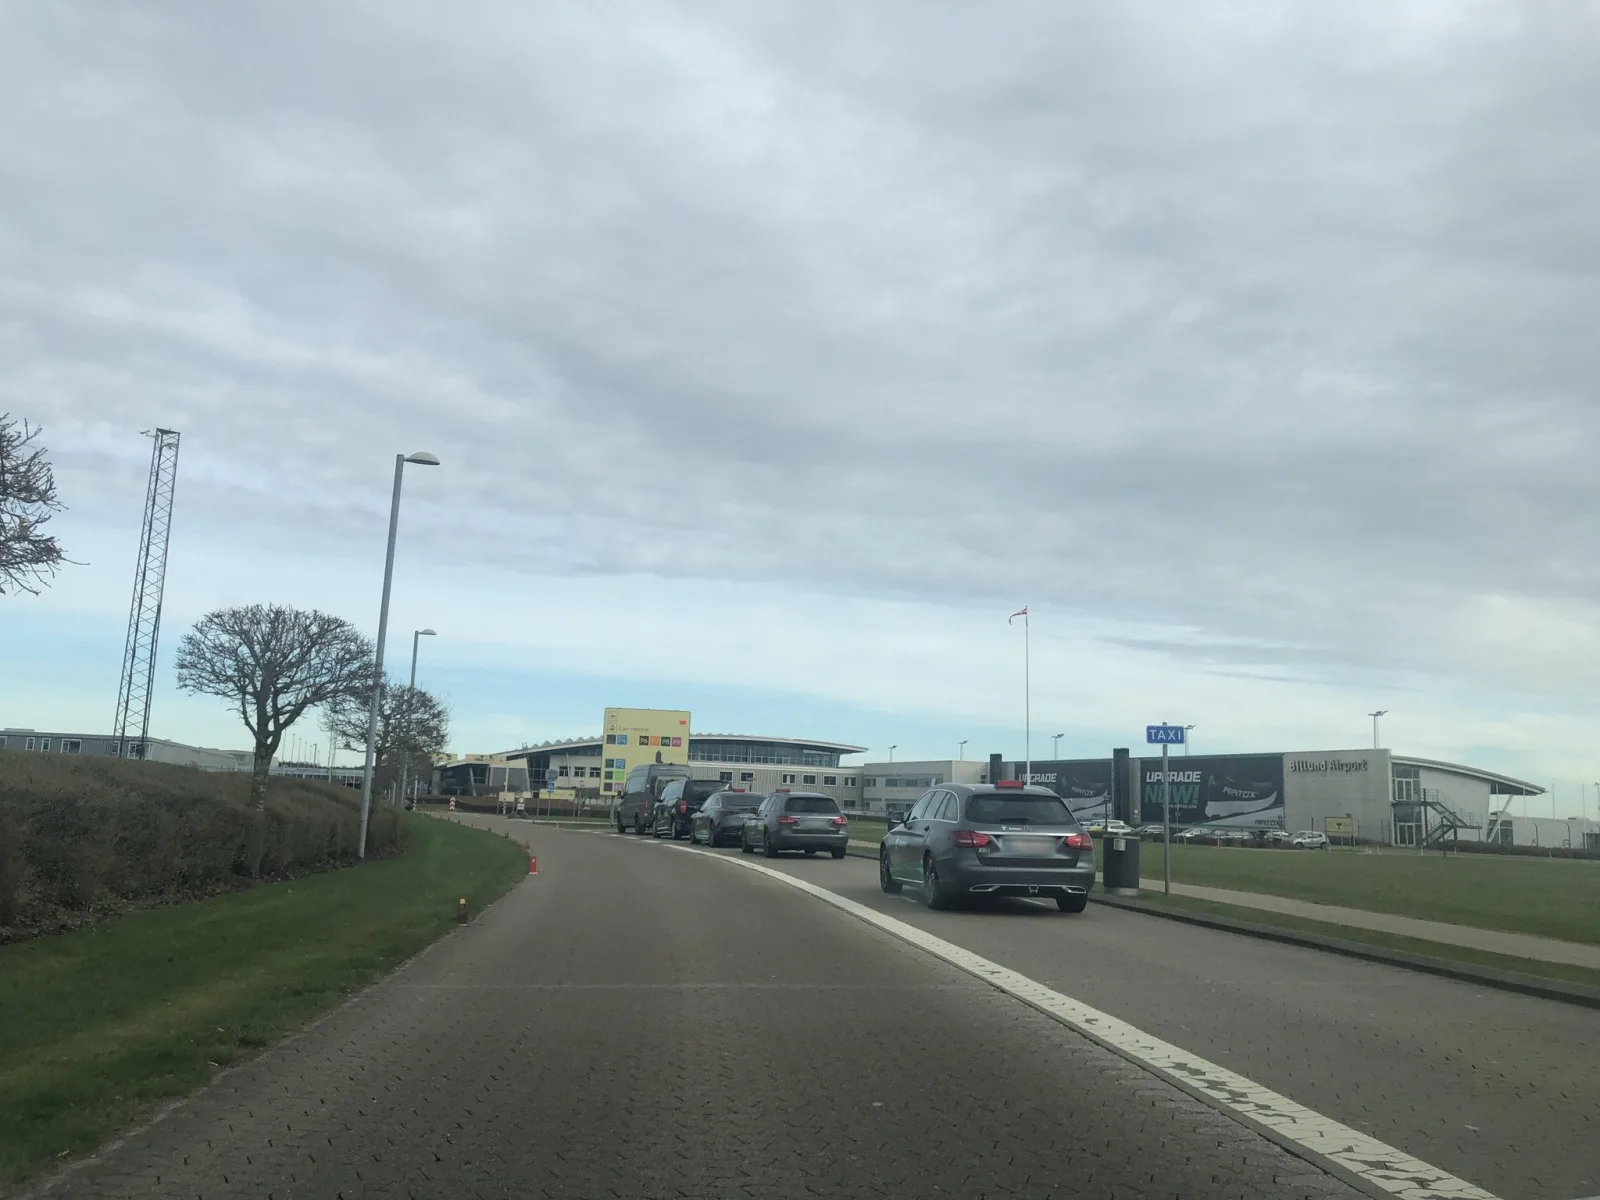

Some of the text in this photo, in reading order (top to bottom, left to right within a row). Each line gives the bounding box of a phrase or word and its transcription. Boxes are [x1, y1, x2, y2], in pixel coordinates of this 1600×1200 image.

[1149, 729, 1182, 741] TAXI
[1290, 758, 1368, 773] Billund Airport
[1144, 784, 1200, 804] NOW!
[1222, 786, 1256, 799] AIRTOX
